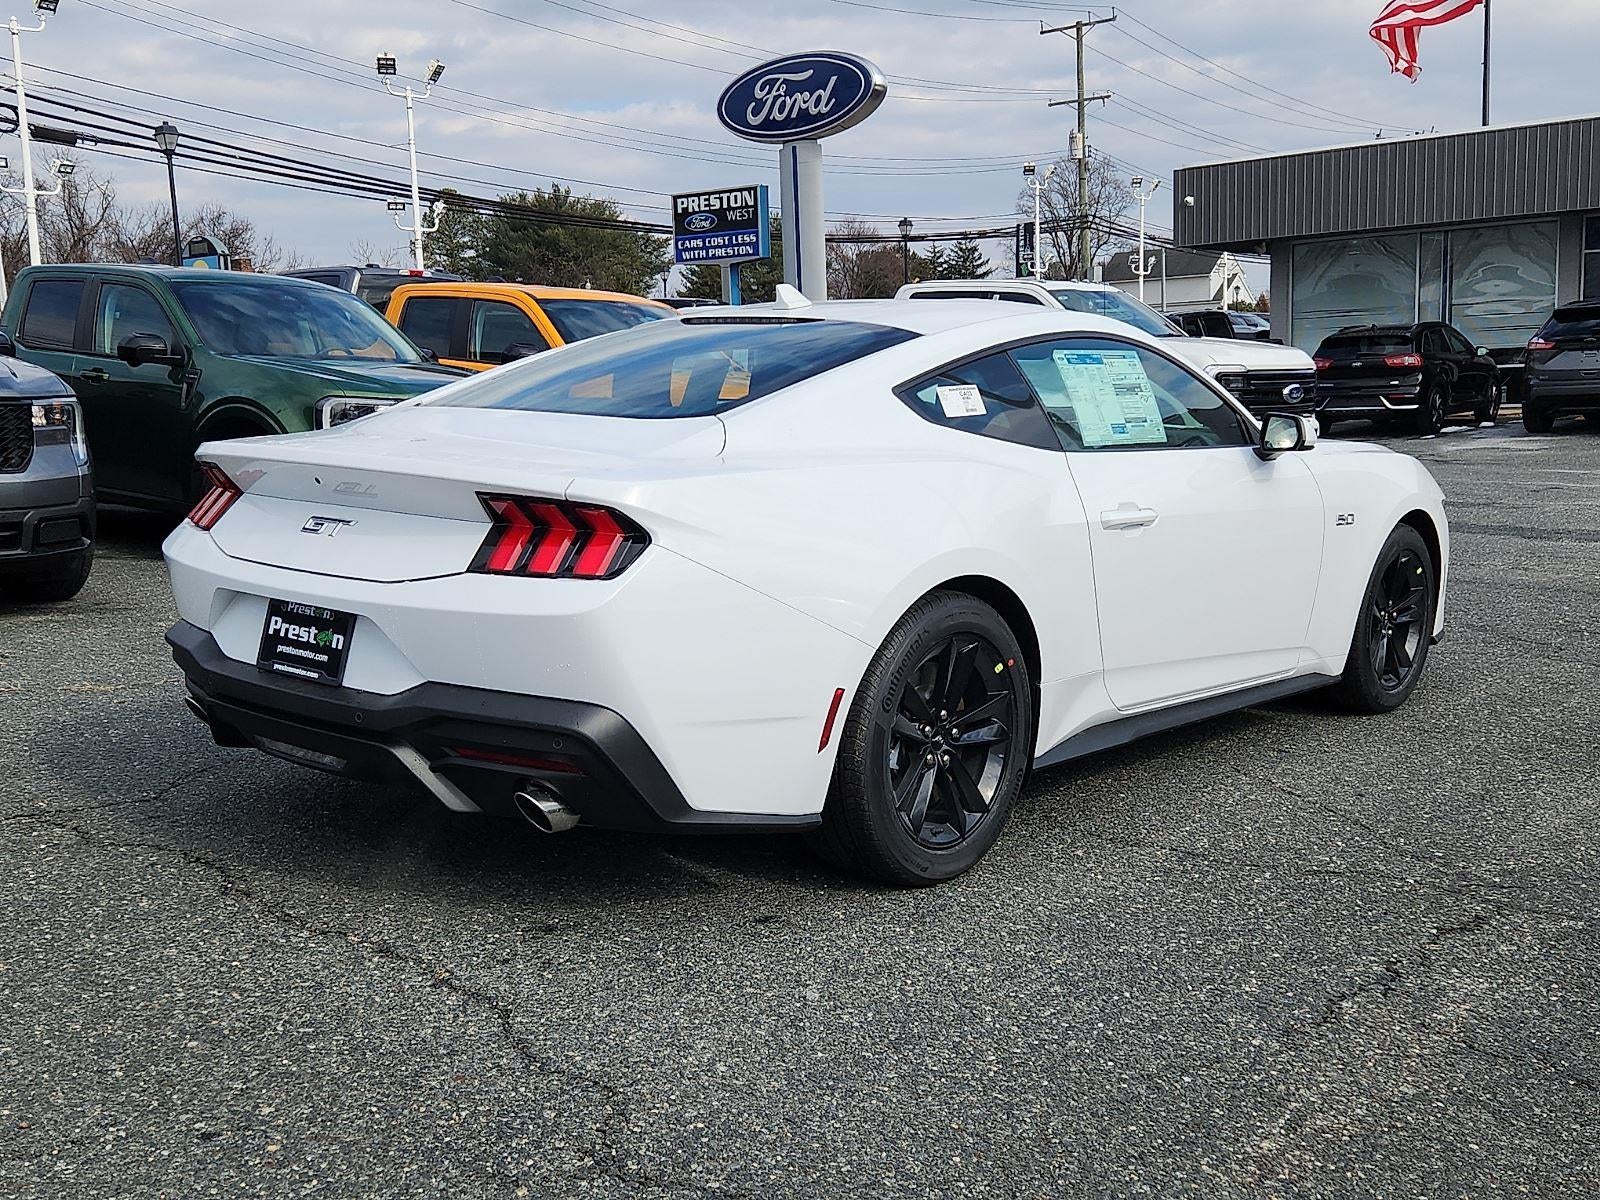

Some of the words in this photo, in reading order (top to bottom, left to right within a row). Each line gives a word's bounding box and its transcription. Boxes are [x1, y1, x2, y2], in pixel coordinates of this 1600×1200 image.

[746, 69, 838, 126] Ford
[677, 190, 755, 213] PRESTON
[690, 216, 711, 229] Ford
[726, 208, 754, 221] WEST
[677, 239, 703, 249] CARS
[705, 236, 730, 246] COST
[732, 233, 757, 244] LESS
[682, 250, 706, 260] WITH
[708, 245, 754, 257] PRESTON
[300, 515, 359, 537] GT
[276, 644, 328, 662] prestonmotor.com
[881, 632, 924, 714] Continental
